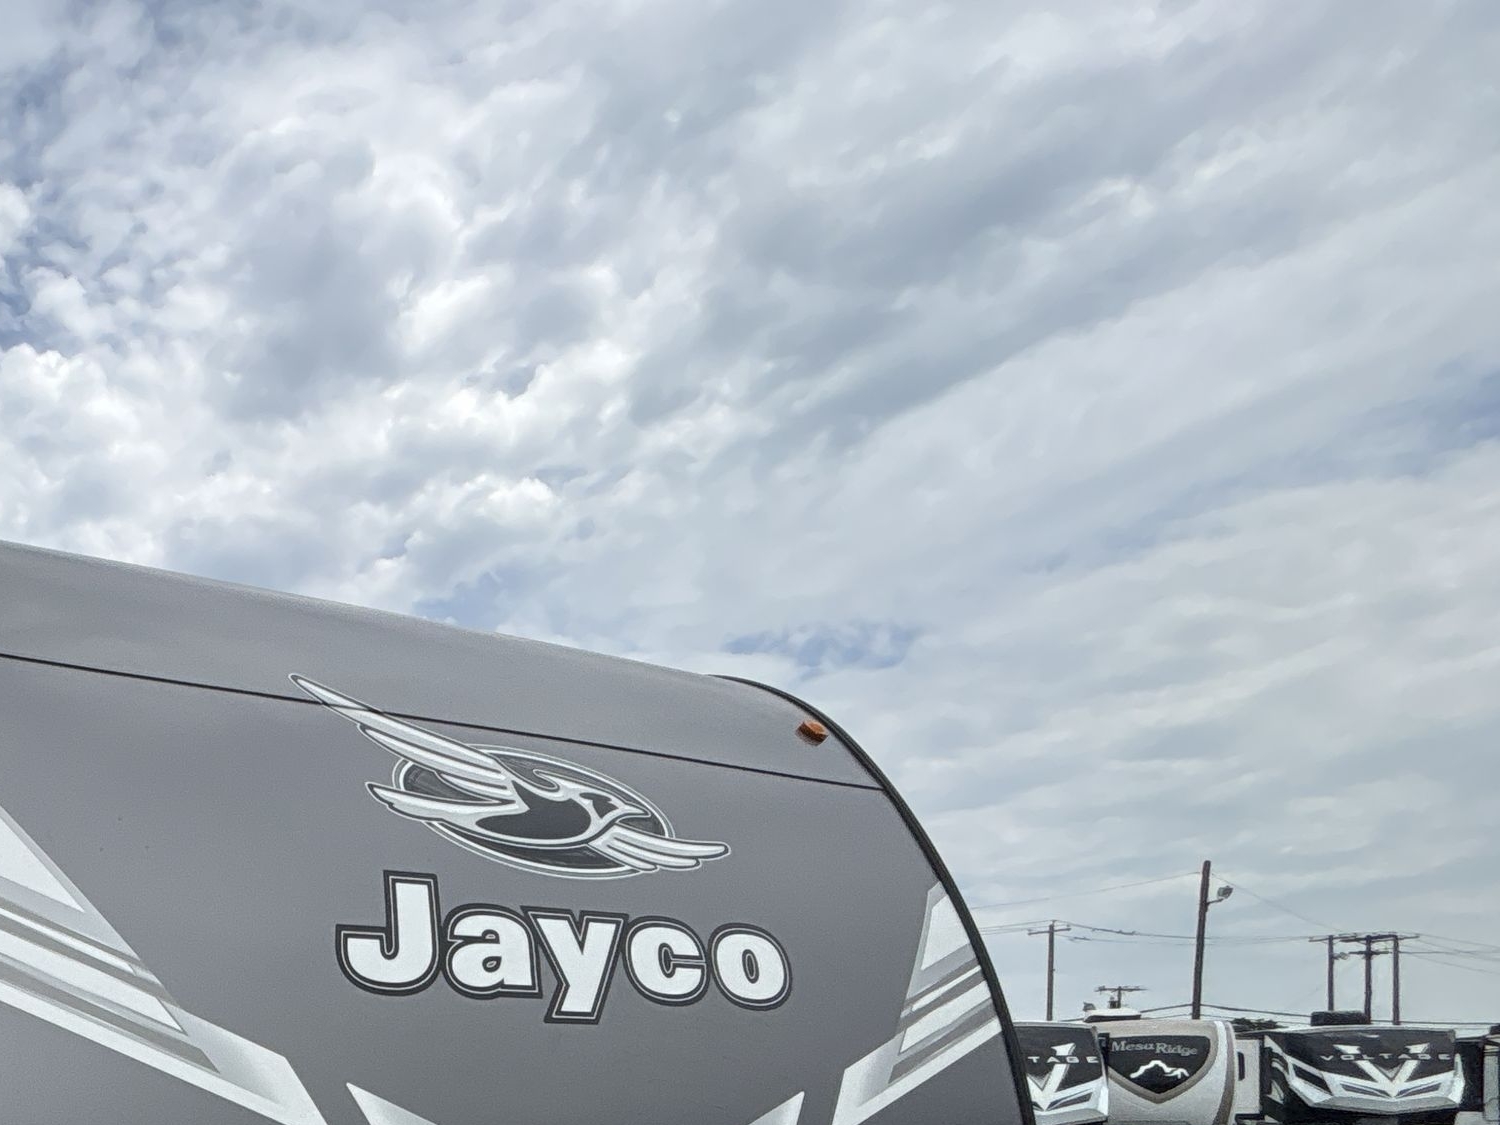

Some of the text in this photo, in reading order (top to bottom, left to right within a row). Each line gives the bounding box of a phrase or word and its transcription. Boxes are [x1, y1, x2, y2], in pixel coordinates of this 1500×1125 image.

[335, 870, 792, 1024] Jayco
[1111, 1041, 1198, 1056] Mesa Ridge
[1027, 1055, 1099, 1064] TAGE
[1320, 1053, 1451, 1061] VOLTAGE
